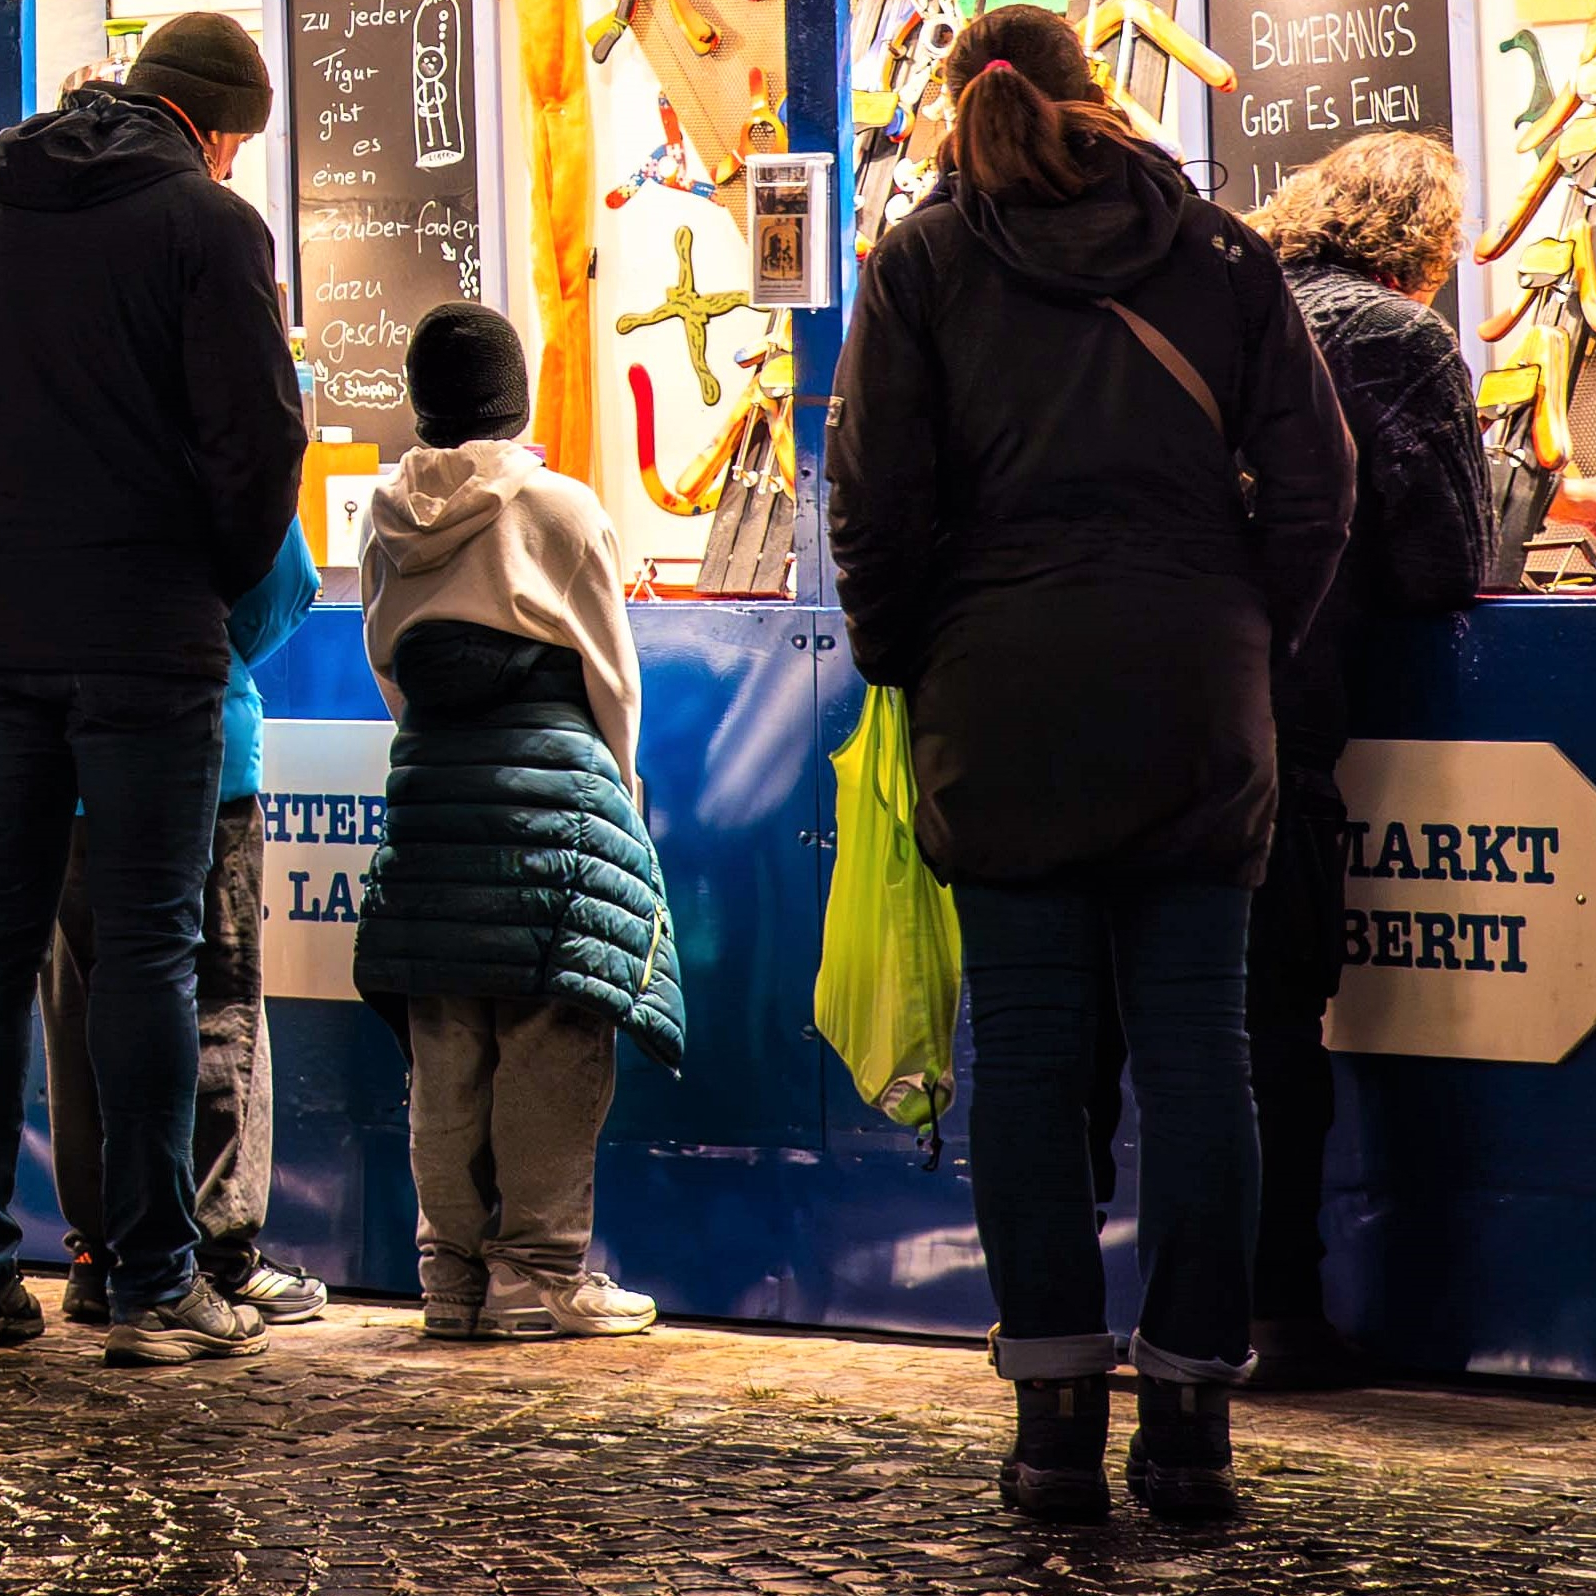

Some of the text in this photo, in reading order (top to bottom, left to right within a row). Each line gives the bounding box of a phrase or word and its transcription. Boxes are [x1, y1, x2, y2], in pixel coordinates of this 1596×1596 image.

[301, 12, 330, 32] zu
[312, 47, 380, 94] Figur
[319, 102, 365, 142] gibt
[353, 137, 382, 156] es
[312, 162, 377, 187] einen
[315, 263, 383, 303] dazu
